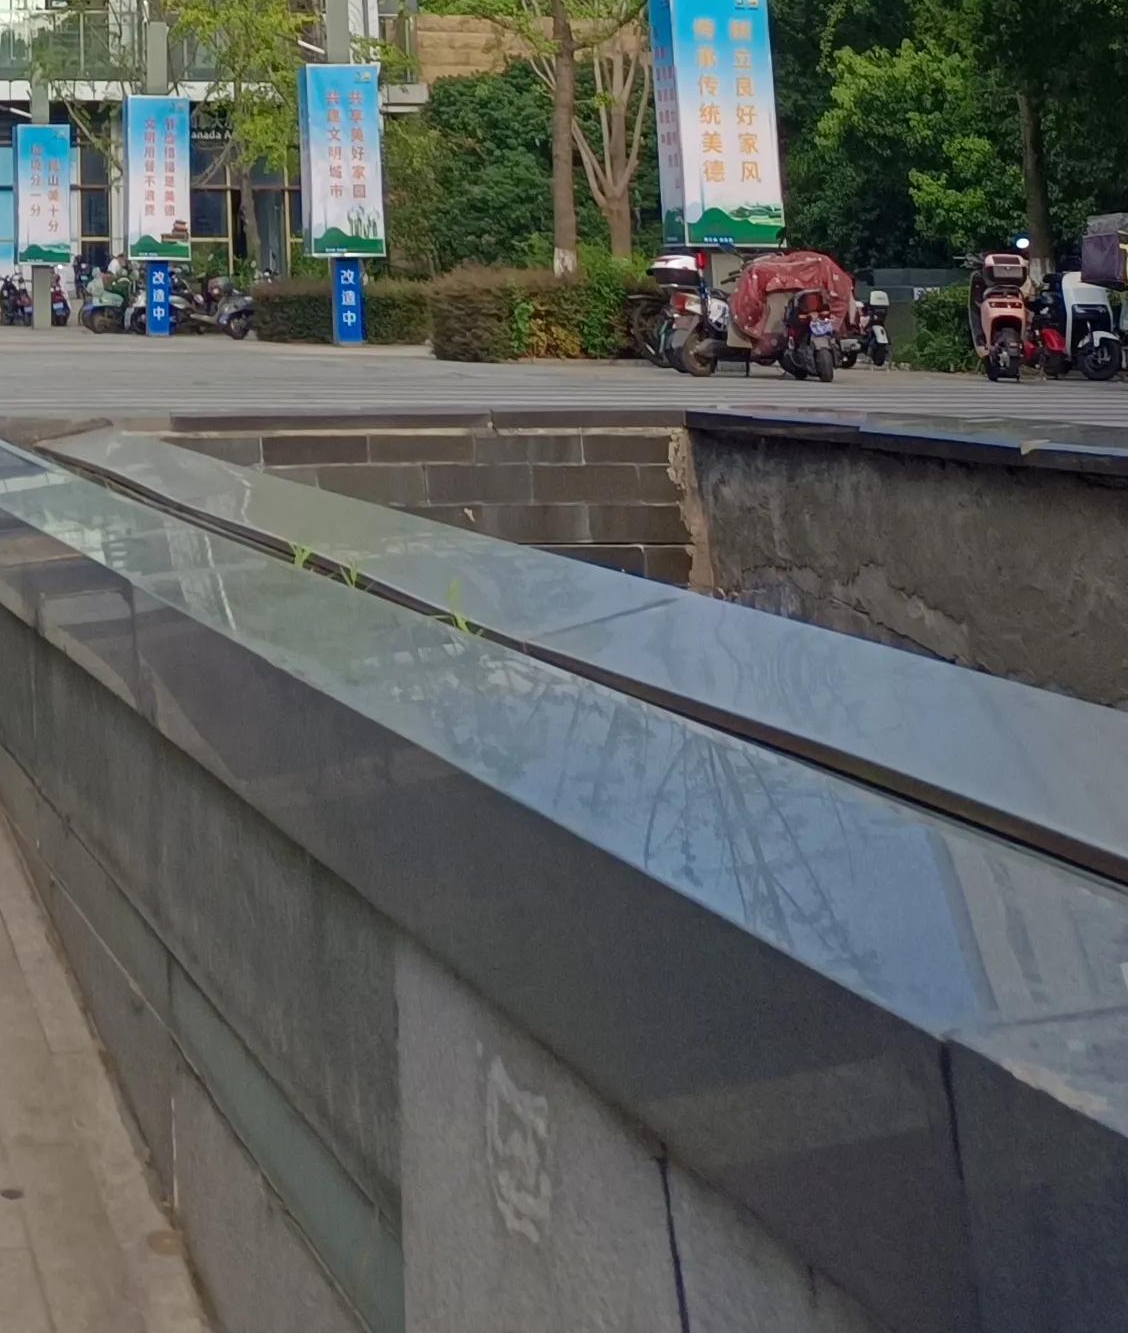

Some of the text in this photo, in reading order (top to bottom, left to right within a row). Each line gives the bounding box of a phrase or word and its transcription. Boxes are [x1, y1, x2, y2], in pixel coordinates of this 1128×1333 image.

[191, 129, 221, 139] anada
[327, 90, 343, 198] 共建文明城市
[349, 90, 366, 198] 共享美好家园
[152, 271, 165, 320] 改造中
[340, 269, 356, 326] 改造中
